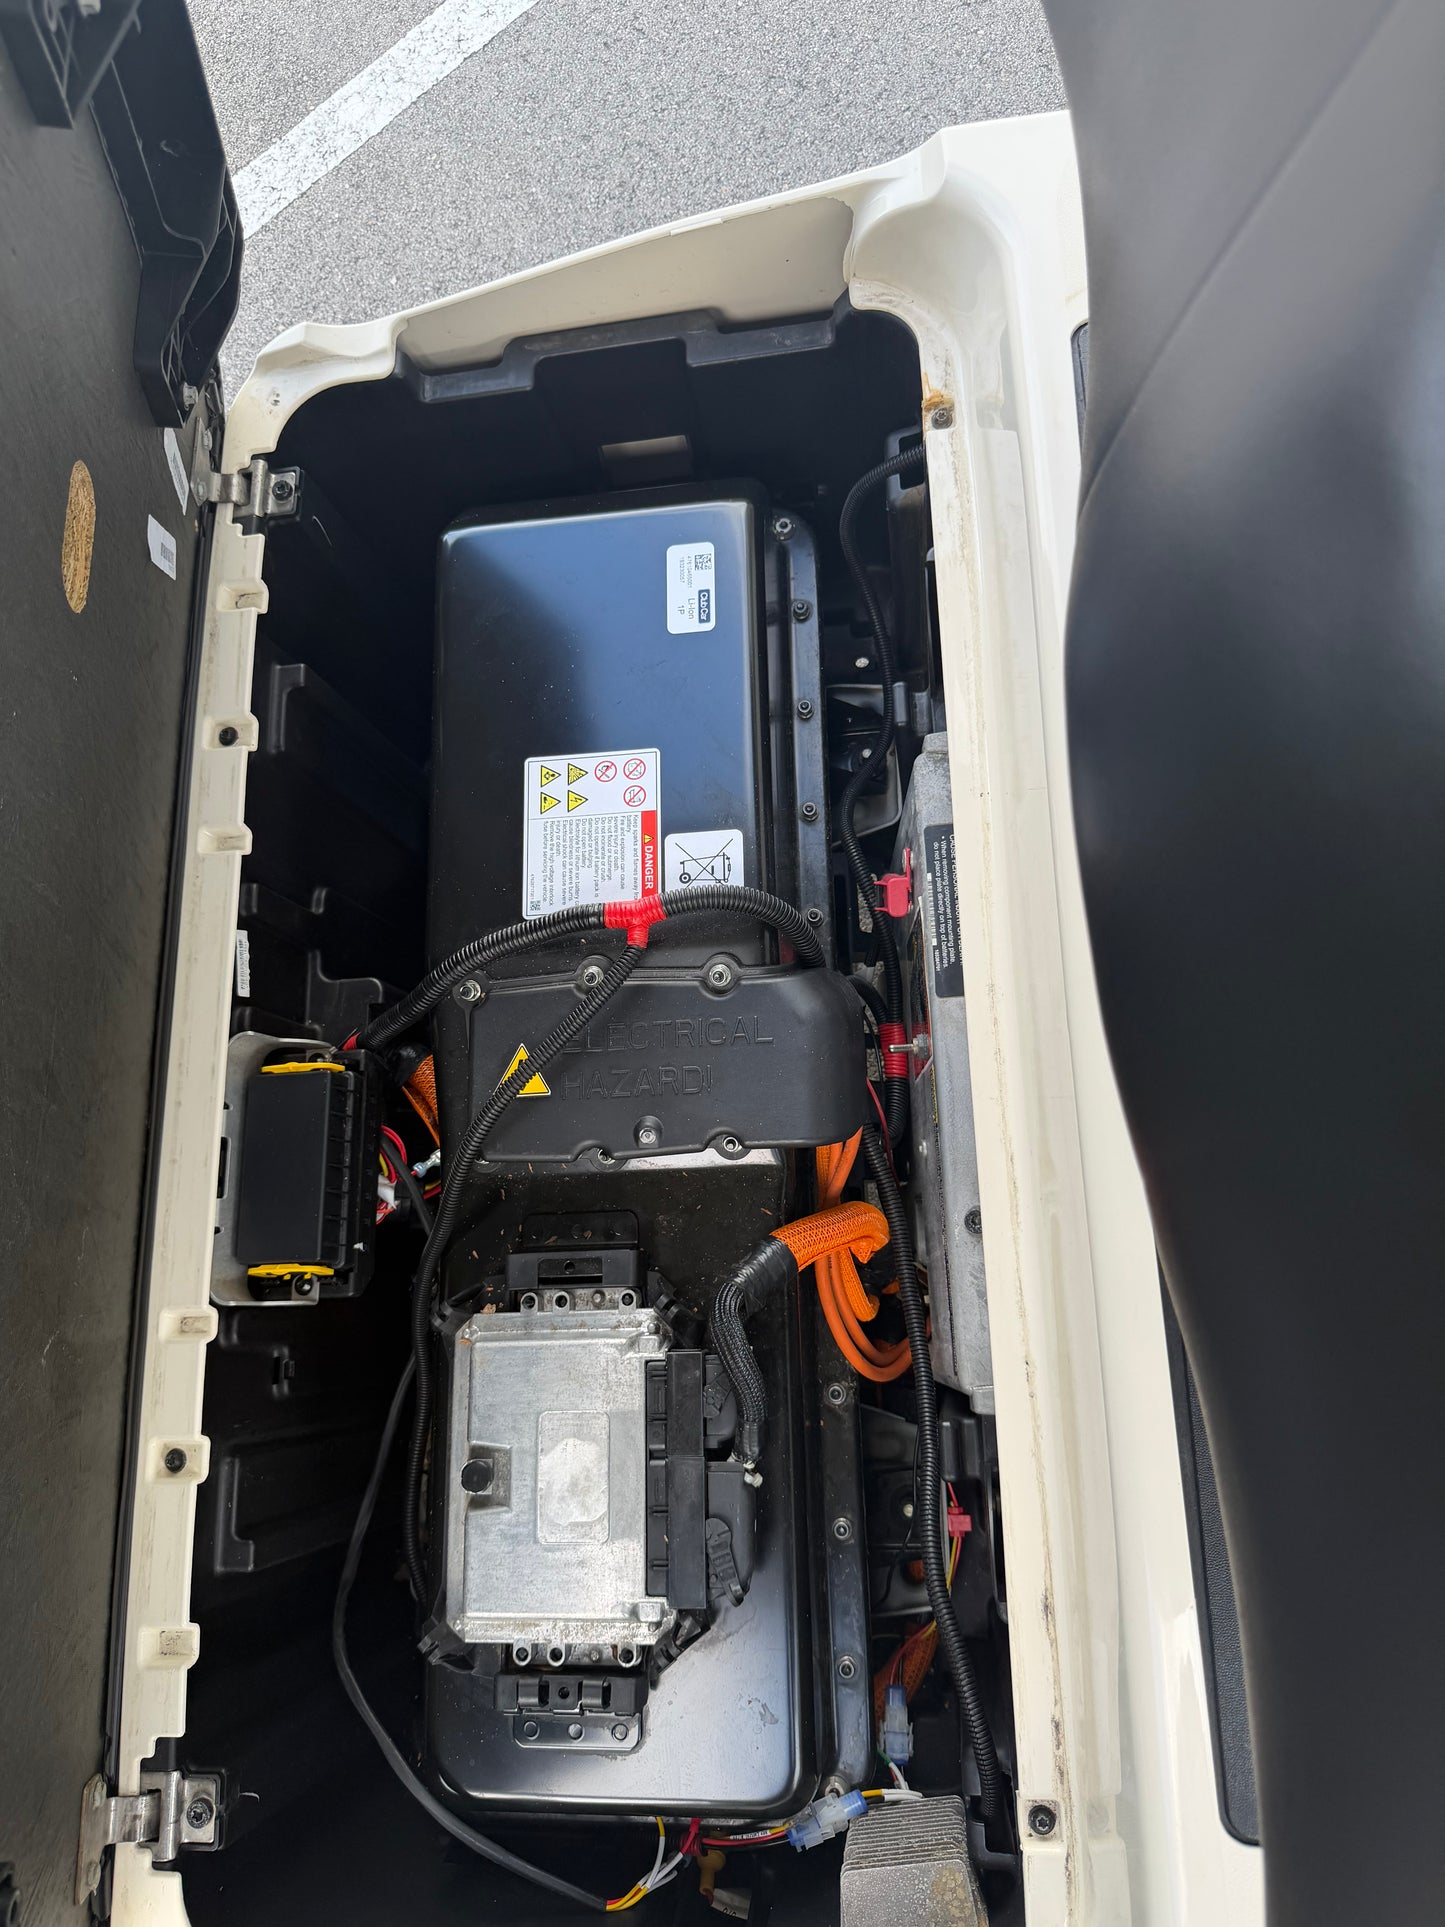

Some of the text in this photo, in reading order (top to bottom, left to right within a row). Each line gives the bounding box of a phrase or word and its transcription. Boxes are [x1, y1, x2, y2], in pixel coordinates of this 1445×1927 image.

[677, 605, 685, 615] 1P
[688, 597, 696, 620] Li-Ion
[700, 592, 708, 621] Club Car
[581, 818, 587, 826] Do
[594, 817, 600, 825] Do
[601, 816, 606, 825] Do
[933, 841, 940, 850] do
[645, 845, 653, 889] DANGER
[934, 861, 942, 877] place
[941, 858, 949, 886] removing
[935, 877, 943, 892] plate
[936, 892, 944, 914] directly
[943, 885, 952, 919] component
[939, 915, 945, 923] on
[940, 934, 946, 942] of
[560, 1064, 712, 1100] HAZARD!
